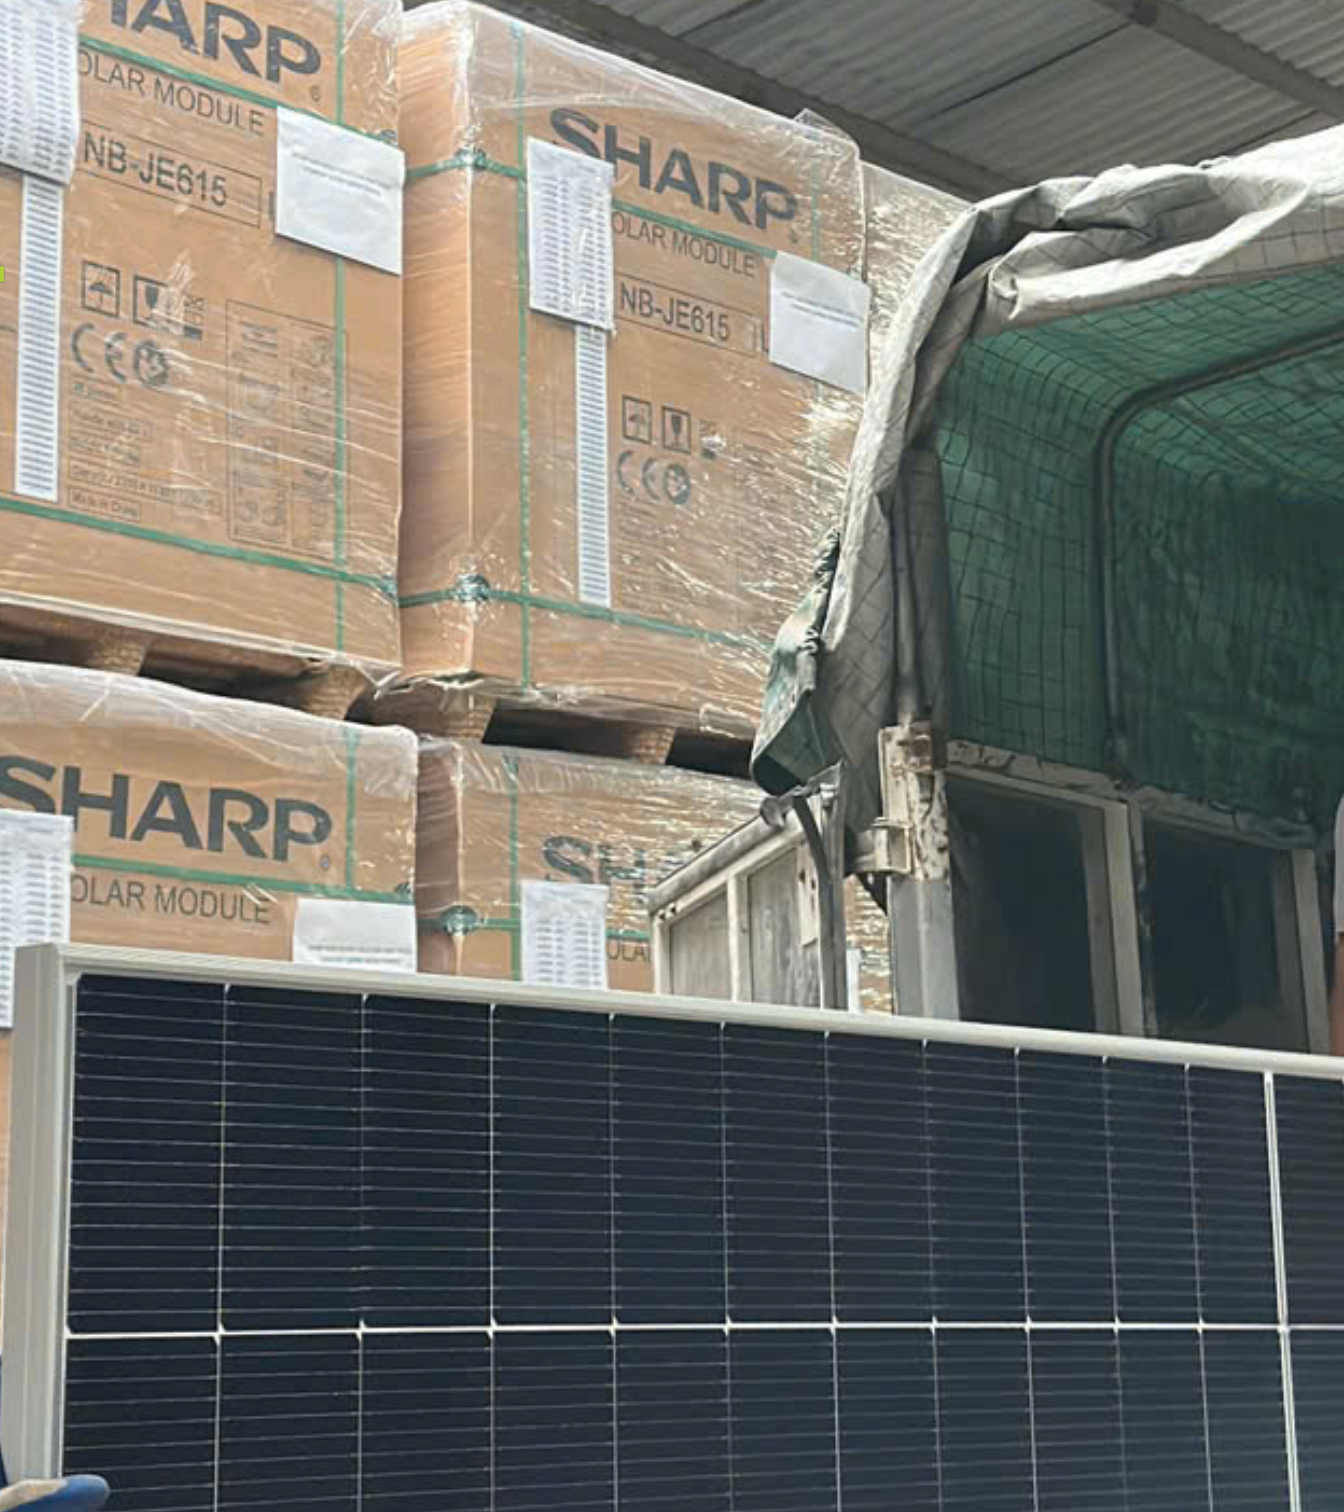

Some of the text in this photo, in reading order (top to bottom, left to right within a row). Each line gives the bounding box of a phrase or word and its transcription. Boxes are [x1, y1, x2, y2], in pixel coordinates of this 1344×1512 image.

[111, 0, 321, 83] ARP
[79, 52, 263, 136] OLAR MODULE
[84, 131, 226, 207] NB-JE615
[551, 108, 797, 230] SHARP
[613, 211, 754, 277] OLAR MODULE
[621, 282, 730, 342] NB-JE615
[71, 874, 271, 924] OLAR MODULE
